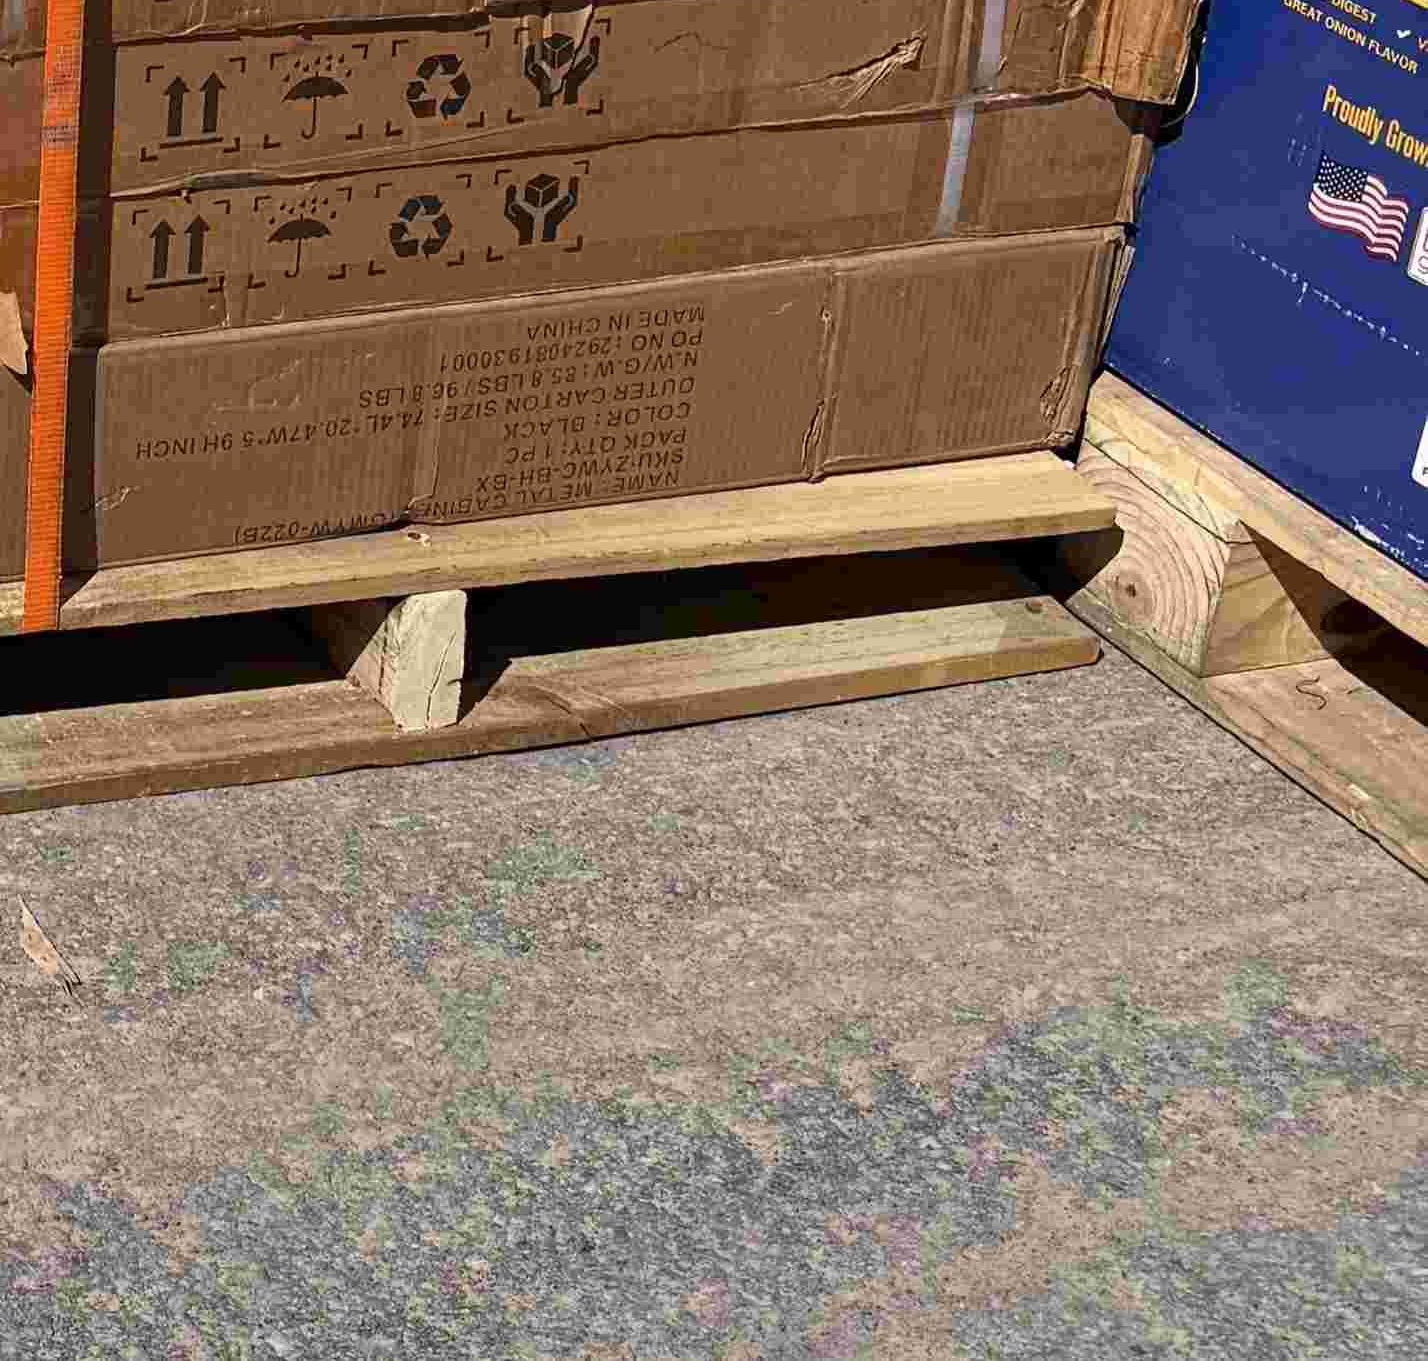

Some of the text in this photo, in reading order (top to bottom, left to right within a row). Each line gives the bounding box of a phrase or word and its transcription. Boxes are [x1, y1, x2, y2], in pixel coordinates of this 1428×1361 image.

[1325, 16, 1367, 46] ONION
[1368, 38, 1419, 75] FLAVOR
[1321, 84, 1385, 145] Proudly
[527, 306, 705, 340] MADE IN CHINA
[631, 333, 664, 352] NO
[671, 330, 703, 349] PO
[478, 373, 523, 395] LBS
[614, 376, 695, 401] OUTER
[358, 387, 405, 409] LBS
[505, 387, 606, 415] CARTON
[434, 400, 498, 422] SIZE:
[503, 416, 585, 440] BLACK
[625, 428, 687, 449] PACK
[135, 437, 196, 459] INCH
[506, 445, 536, 464] PC
[561, 435, 616, 456] QTY:
